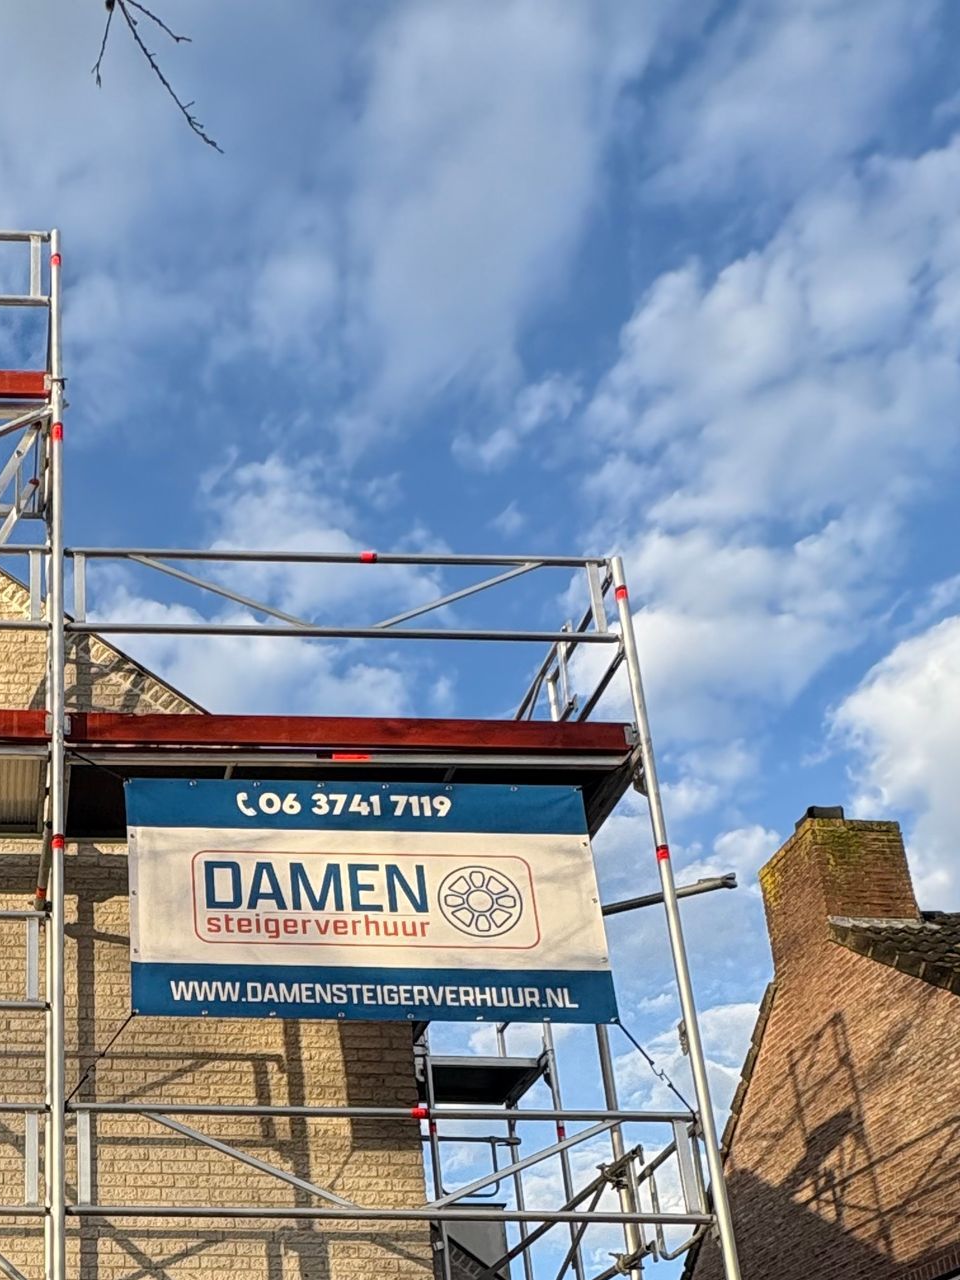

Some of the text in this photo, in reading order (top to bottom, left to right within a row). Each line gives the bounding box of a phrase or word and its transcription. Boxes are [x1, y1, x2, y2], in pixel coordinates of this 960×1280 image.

[258, 792, 452, 817] 06 3741 7119
[204, 860, 429, 913] DAMEN
[206, 914, 430, 939] steigerverhuur
[170, 980, 580, 1008] WWW.DAMENSTEIGERVERHUUR.NL
